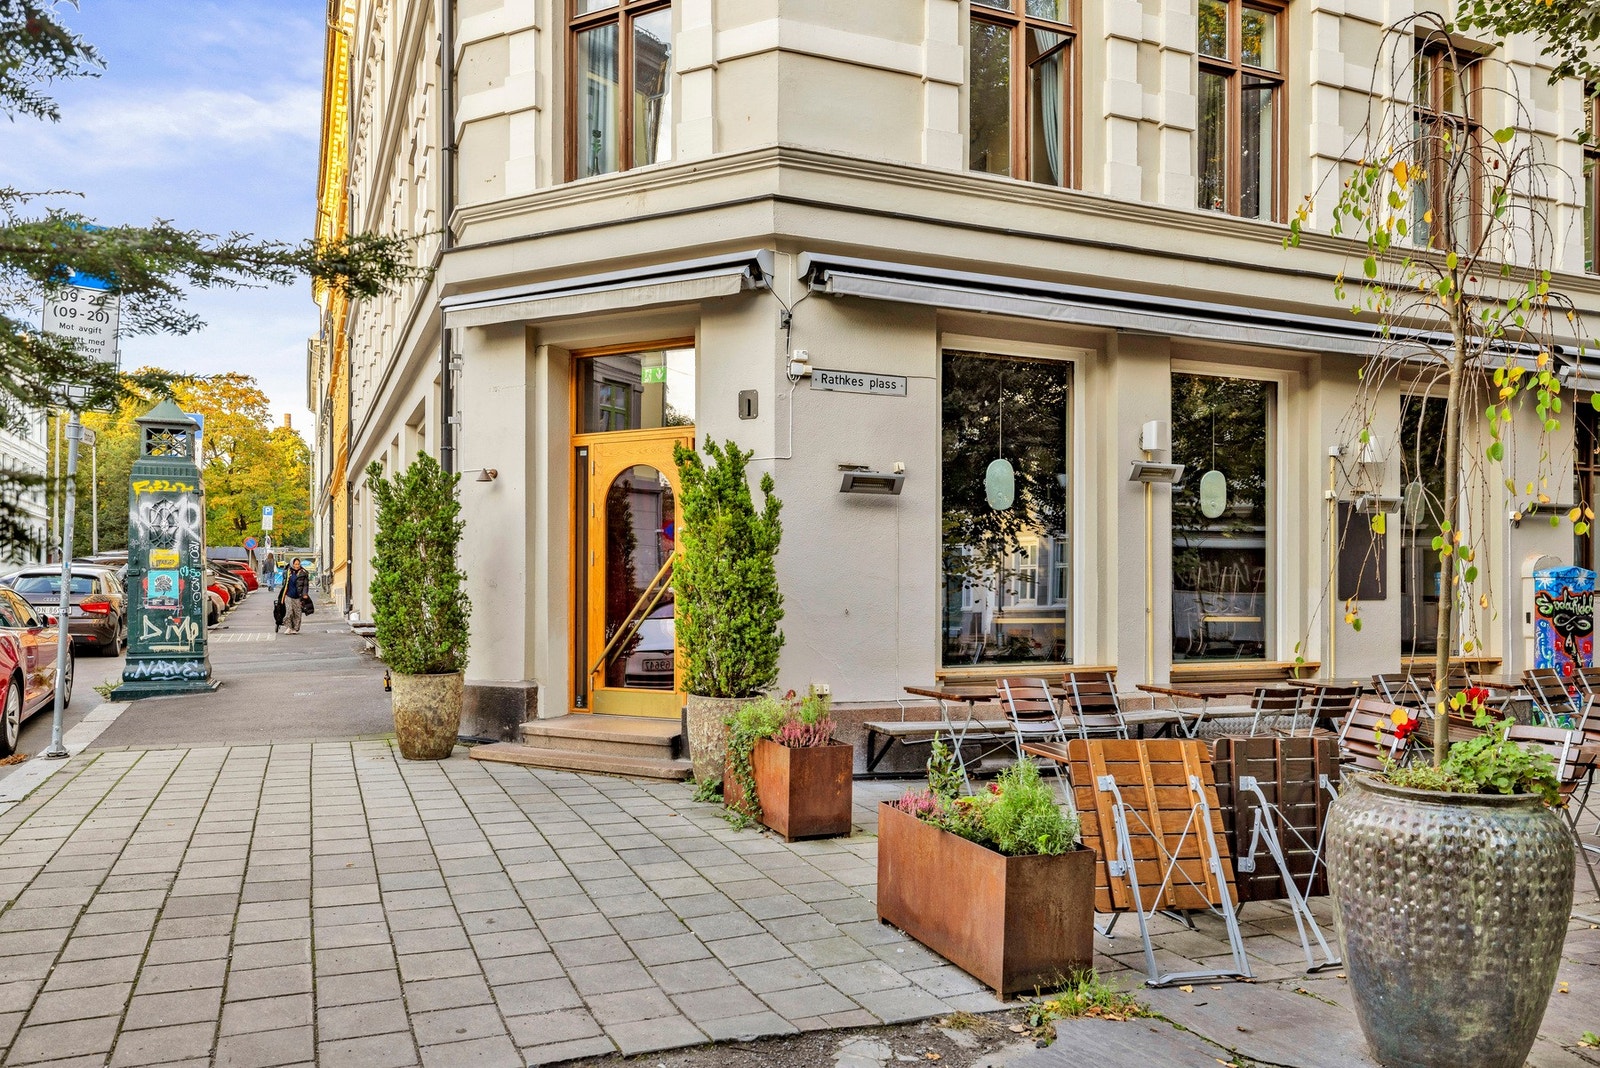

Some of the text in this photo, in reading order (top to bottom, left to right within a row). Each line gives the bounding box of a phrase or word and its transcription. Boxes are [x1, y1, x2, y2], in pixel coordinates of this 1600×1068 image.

[59, 322, 102, 335] Mot avgift
[88, 338, 106, 347] med
[821, 373, 897, 390] Rathkes plass
[264, 507, 272, 515] P
